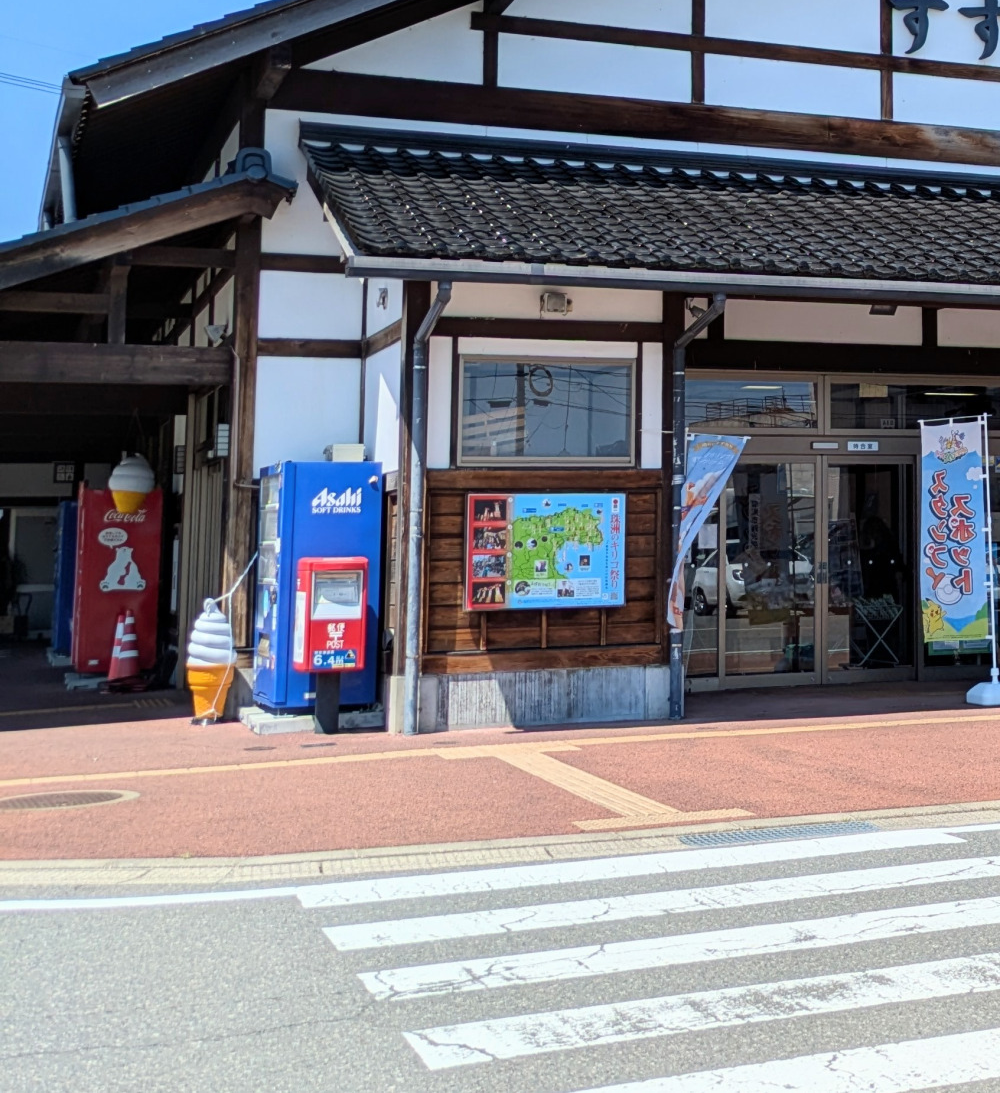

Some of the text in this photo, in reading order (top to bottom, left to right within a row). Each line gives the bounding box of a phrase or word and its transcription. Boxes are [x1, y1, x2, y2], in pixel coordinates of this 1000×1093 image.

[311, 487, 362, 507] Asahi
[610, 514, 620, 590] 珠洲のキリコ祭り
[327, 622, 346, 633] 郵便
[326, 640, 344, 649] POST
